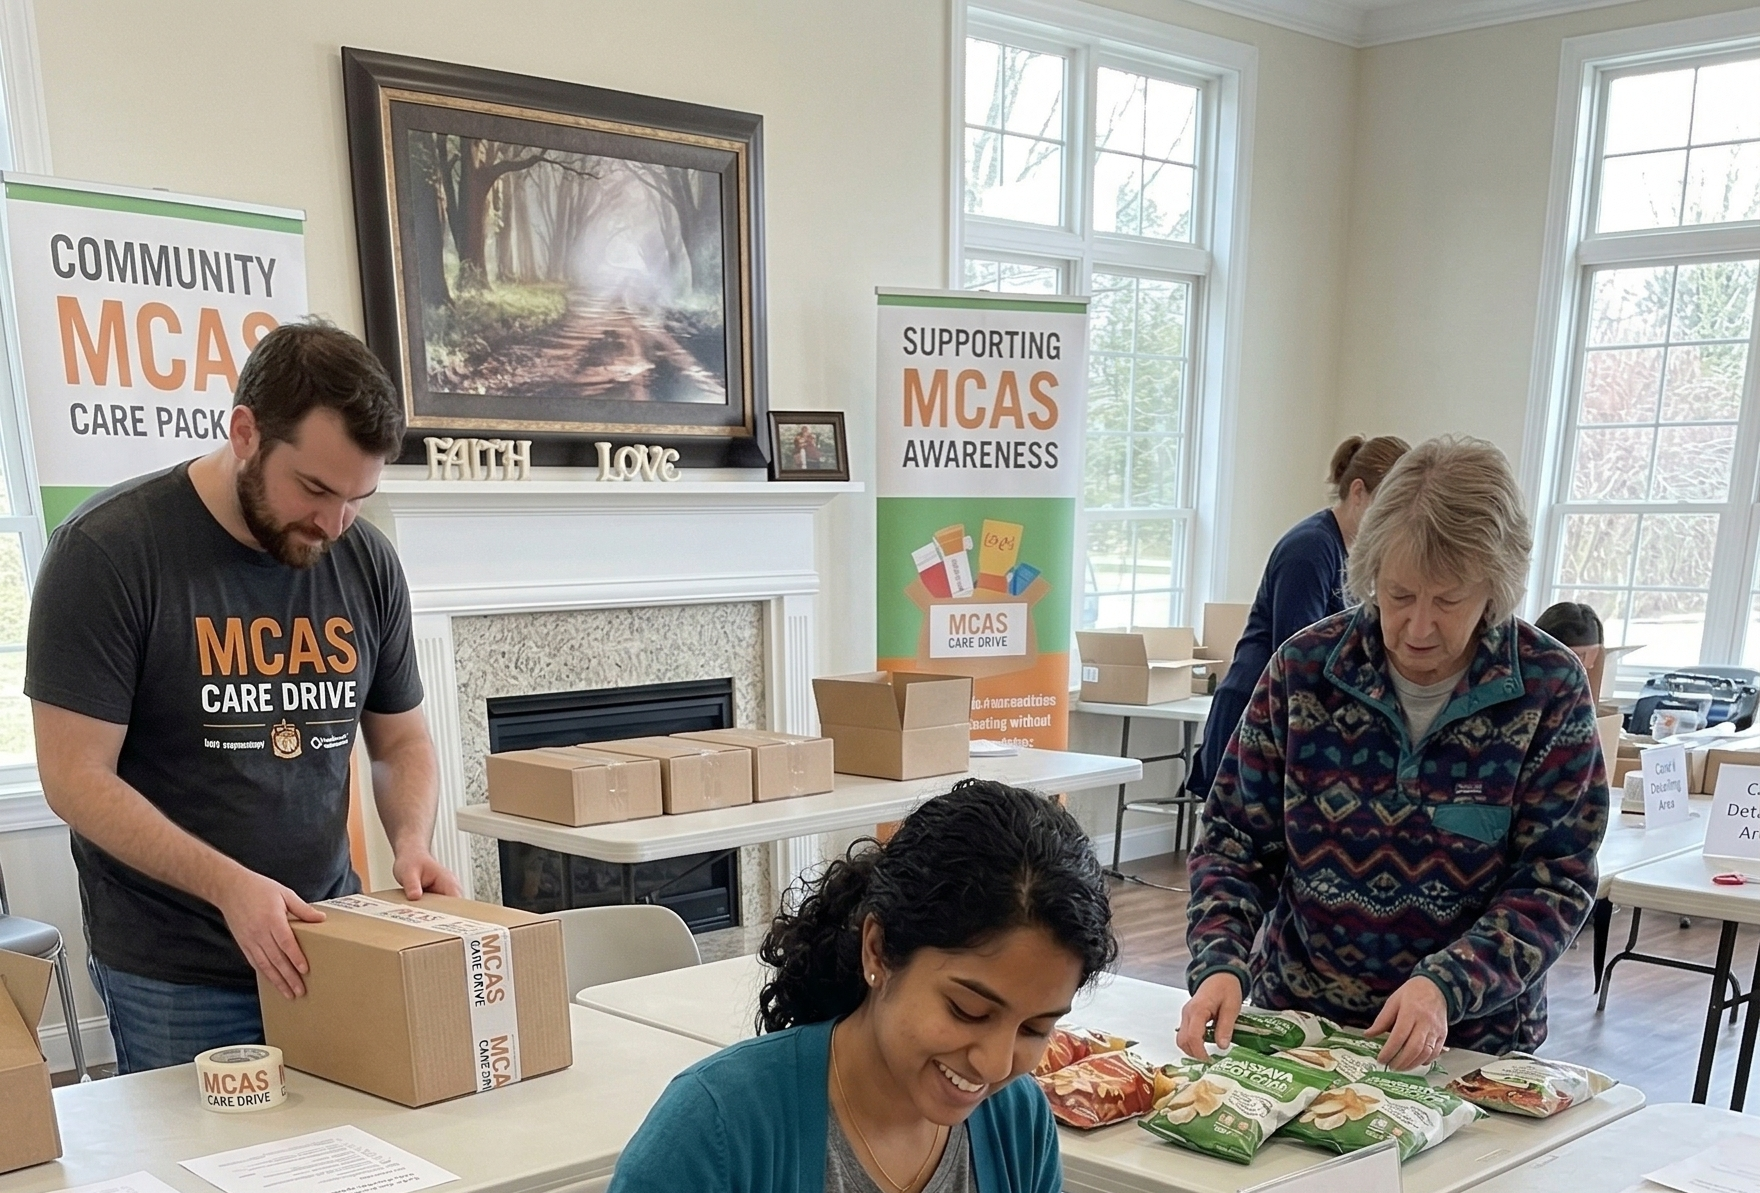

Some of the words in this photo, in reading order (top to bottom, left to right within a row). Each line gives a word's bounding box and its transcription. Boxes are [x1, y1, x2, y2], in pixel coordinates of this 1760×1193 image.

[50, 233, 277, 298] COMMUNITY
[902, 326, 1061, 360] SUPPORTING
[903, 368, 1059, 430] MCAS
[69, 402, 148, 437] CARE
[156, 406, 229, 440] PACK
[424, 436, 533, 481] FAITH
[594, 441, 681, 482] LOVE
[902, 439, 1059, 469] AWARENESS
[949, 612, 1008, 635] MCAS
[195, 617, 357, 676] MCAS
[948, 637, 974, 648] CARE
[978, 636, 1007, 647] DRIVE
[201, 683, 274, 713] CARE
[282, 681, 357, 711] DRIVE
[1739, 826, 1760, 840] Ar
[481, 933, 505, 1005] MCAS
[203, 1069, 269, 1094] MCAS
[207, 1094, 235, 1107] CARE
[236, 1091, 271, 1107] DRIVE
